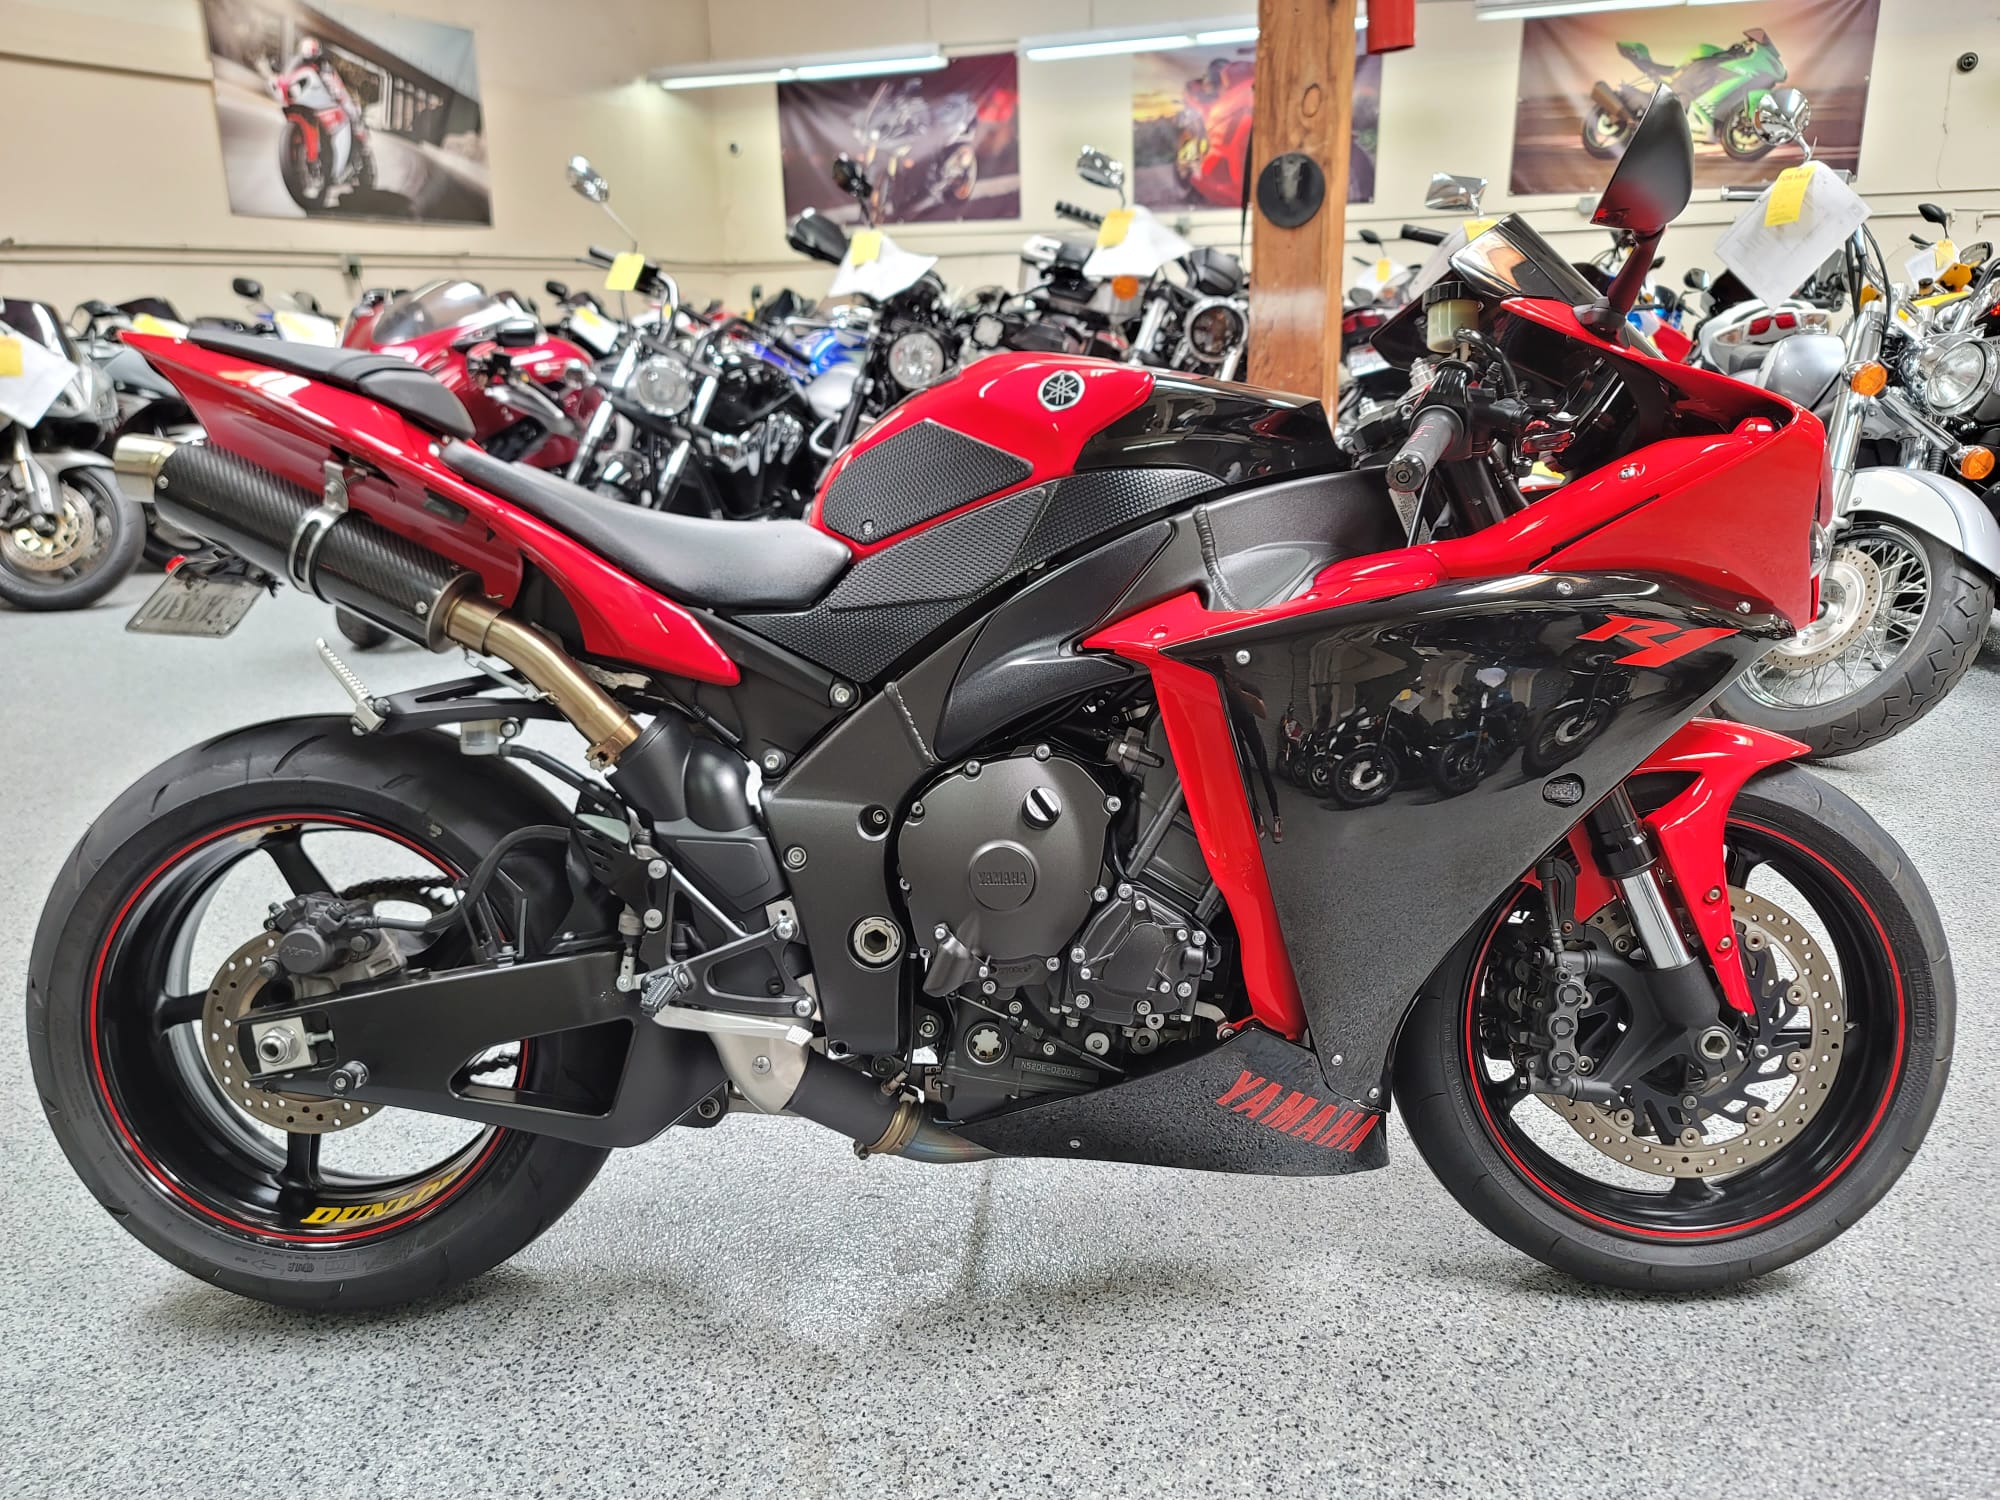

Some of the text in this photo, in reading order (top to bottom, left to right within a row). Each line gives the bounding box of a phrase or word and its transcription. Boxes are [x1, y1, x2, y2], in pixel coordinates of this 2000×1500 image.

[1576, 613, 1742, 668] R1
[977, 871, 1028, 886] YAMAHA
[1216, 1069, 1380, 1152] YAMAHA
[300, 1167, 464, 1225] DUNLOP
